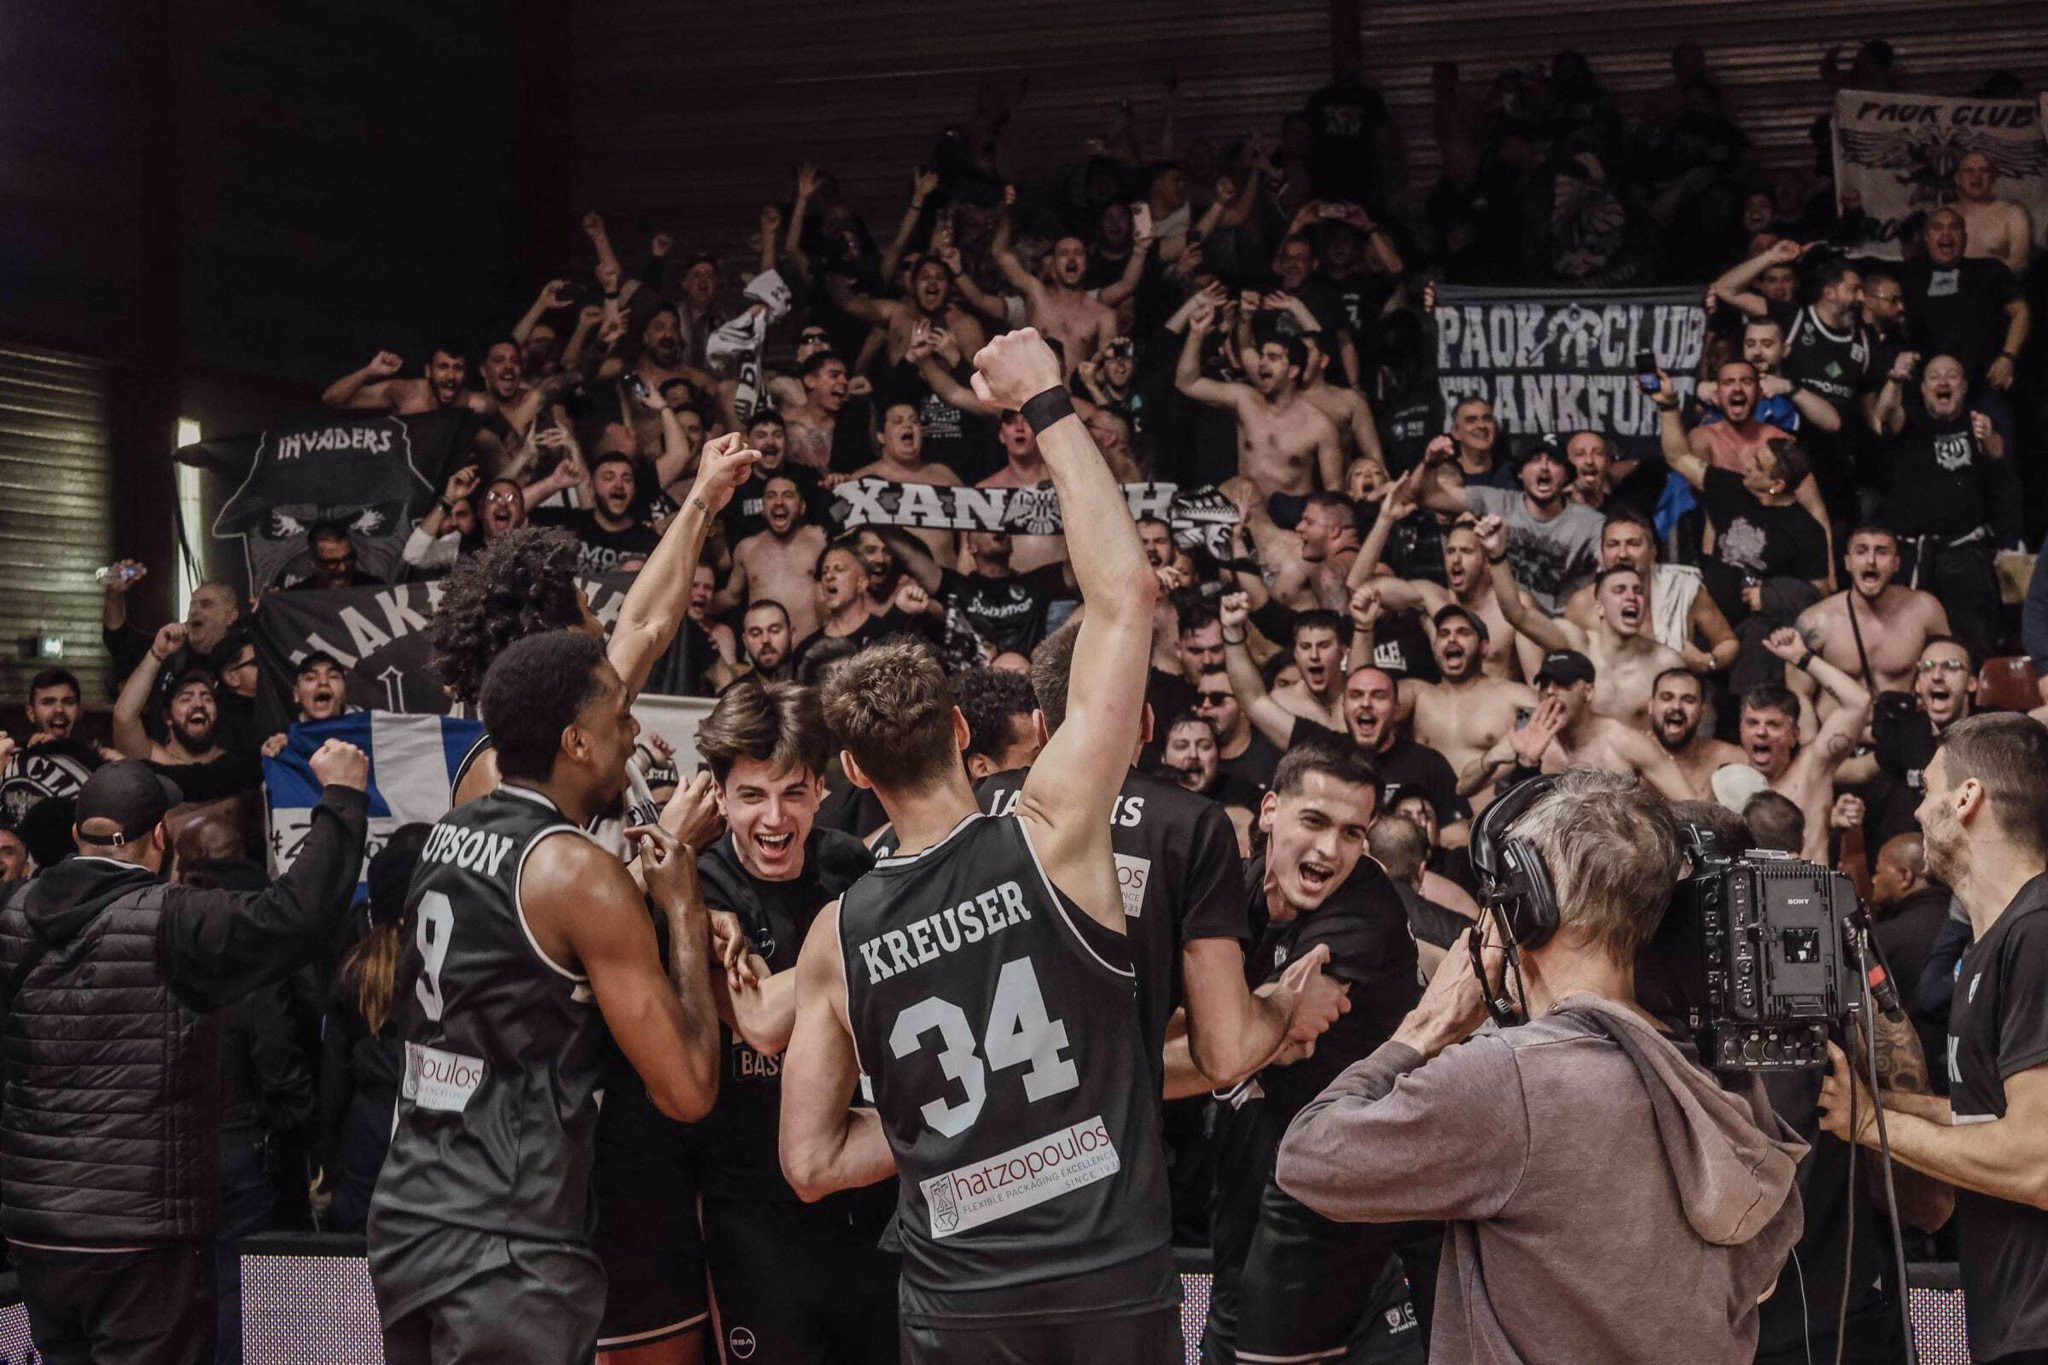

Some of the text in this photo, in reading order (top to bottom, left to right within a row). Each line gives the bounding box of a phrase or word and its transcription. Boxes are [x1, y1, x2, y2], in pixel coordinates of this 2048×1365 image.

[1951, 105, 2036, 128] CLUB
[1434, 304, 1545, 368] PAOK
[278, 427, 392, 460] INVADERS
[422, 823, 514, 877] UPSON
[415, 889, 455, 1023] 9
[859, 880, 1033, 985] KREUSER
[888, 955, 1081, 1138] 34
[951, 1125, 1110, 1200] hatzopoulos
[1065, 1170, 1096, 1189] SINCE
[962, 1193, 1004, 1214] FLEXIBLE
[1005, 1172, 1059, 1199] PACKAGING
